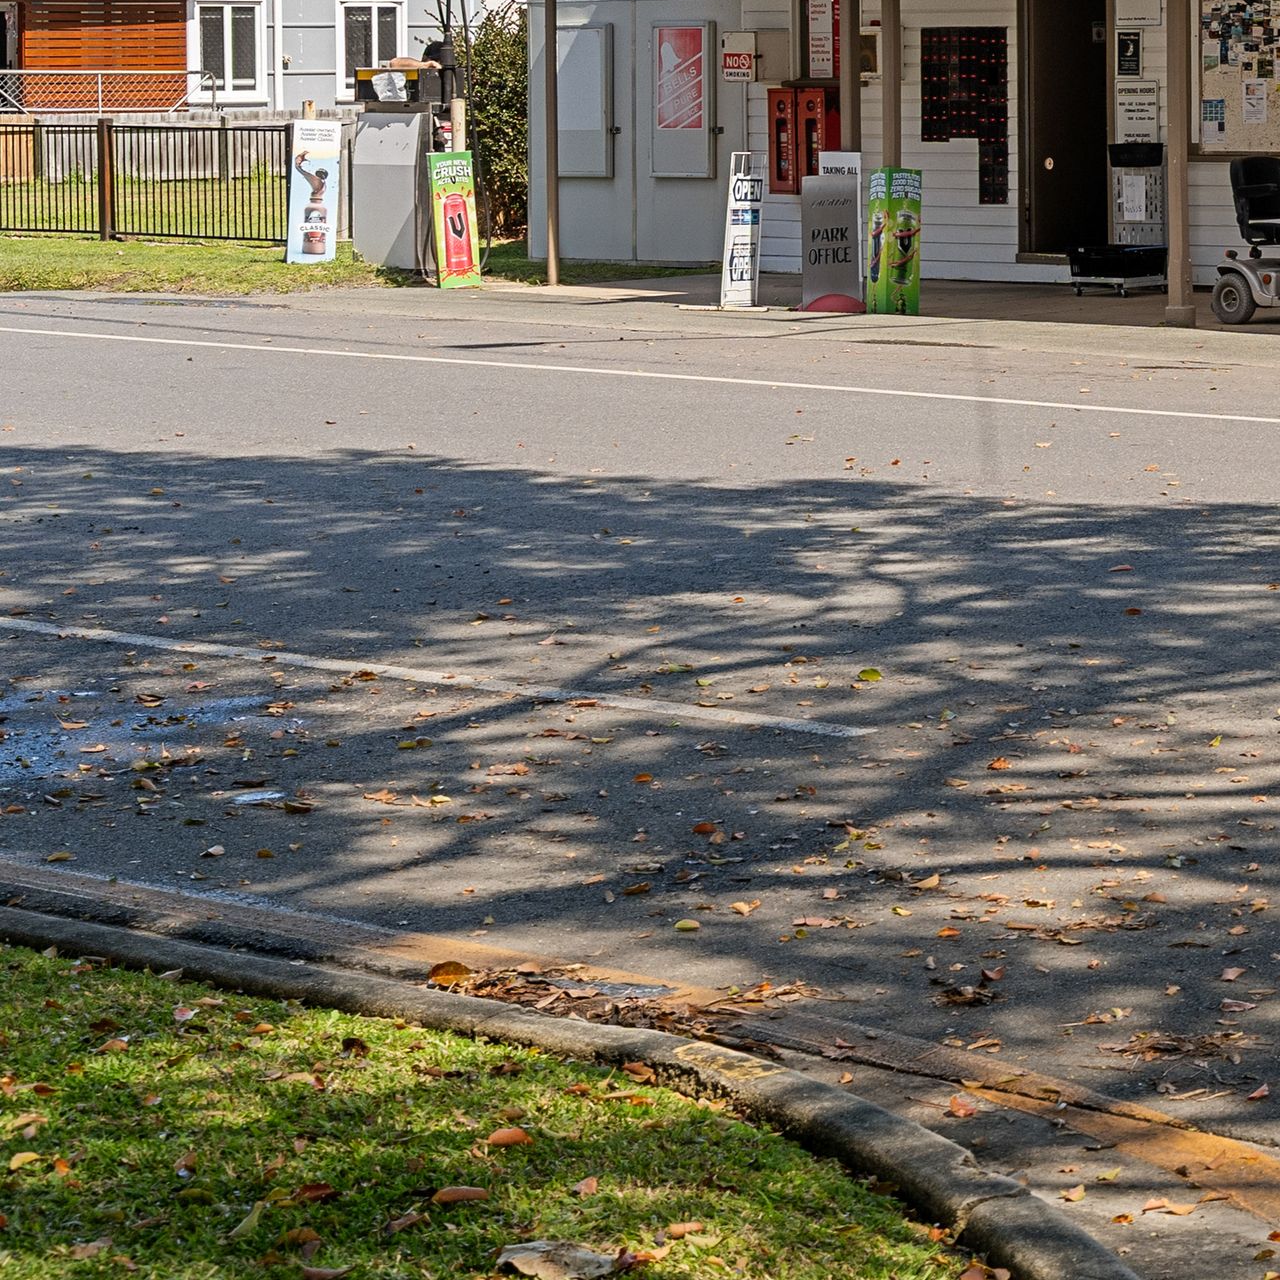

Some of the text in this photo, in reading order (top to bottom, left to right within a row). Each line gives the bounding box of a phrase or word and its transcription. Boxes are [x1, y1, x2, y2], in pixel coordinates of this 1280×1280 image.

[726, 56, 738, 67] NO
[663, 66, 697, 95] BELLS
[673, 88, 698, 109] PURE
[434, 165, 471, 180] CRUSH
[822, 166, 858, 175] TAKING ALL
[735, 180, 761, 200] OPEN
[300, 225, 330, 233] CLASSIC
[811, 226, 849, 242] PARK
[808, 246, 852, 265] OFFICE
